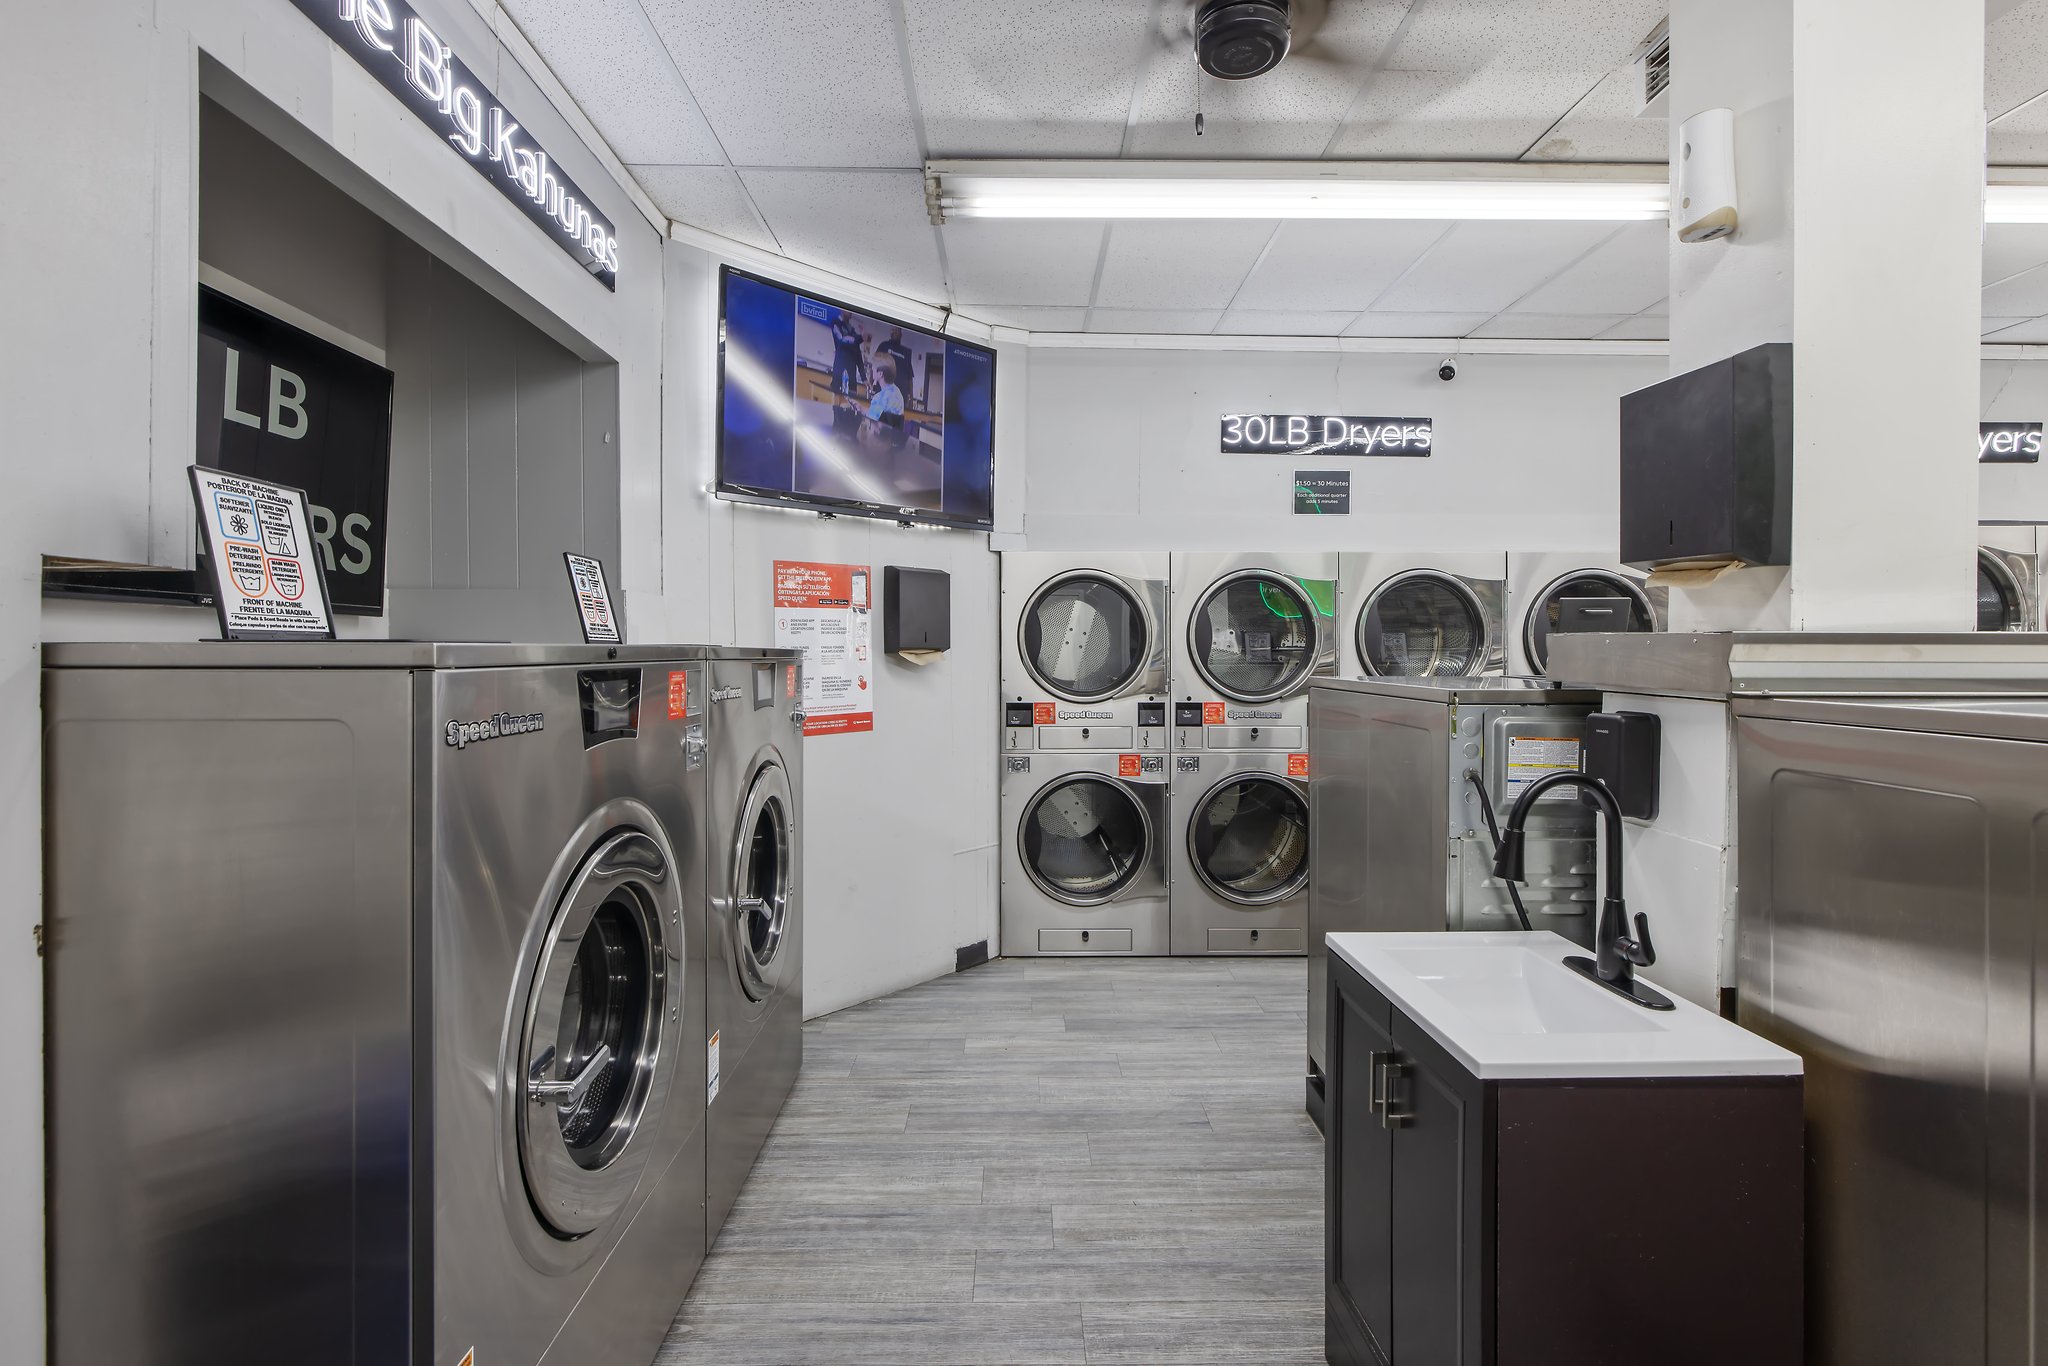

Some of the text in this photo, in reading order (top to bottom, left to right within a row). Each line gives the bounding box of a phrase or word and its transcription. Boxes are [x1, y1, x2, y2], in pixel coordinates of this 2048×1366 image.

[404, 18, 481, 155] Big
[489, 106, 618, 273] Kahunas
[803, 304, 825, 318] bviral
[224, 347, 309, 440] LB
[1222, 415, 1432, 454] 30LB Dryers
[1978, 430, 2043, 459] yers
[207, 481, 247, 495] POSTERIOR
[257, 492, 266, 500] LA
[221, 478, 241, 487] BACK
[252, 484, 279, 496] MACHINE
[220, 497, 250, 507] SOFTENER
[229, 552, 262, 561] DETERGENT
[239, 606, 266, 614] FRENTE
[242, 598, 303, 608] FRONT OF MACHINE
[1059, 710, 1086, 720] Speed
[1086, 710, 1113, 719] Queen
[1228, 711, 1254, 720] Speed
[1254, 711, 1282, 719] Queen
[445, 712, 544, 750] Speed Queen
